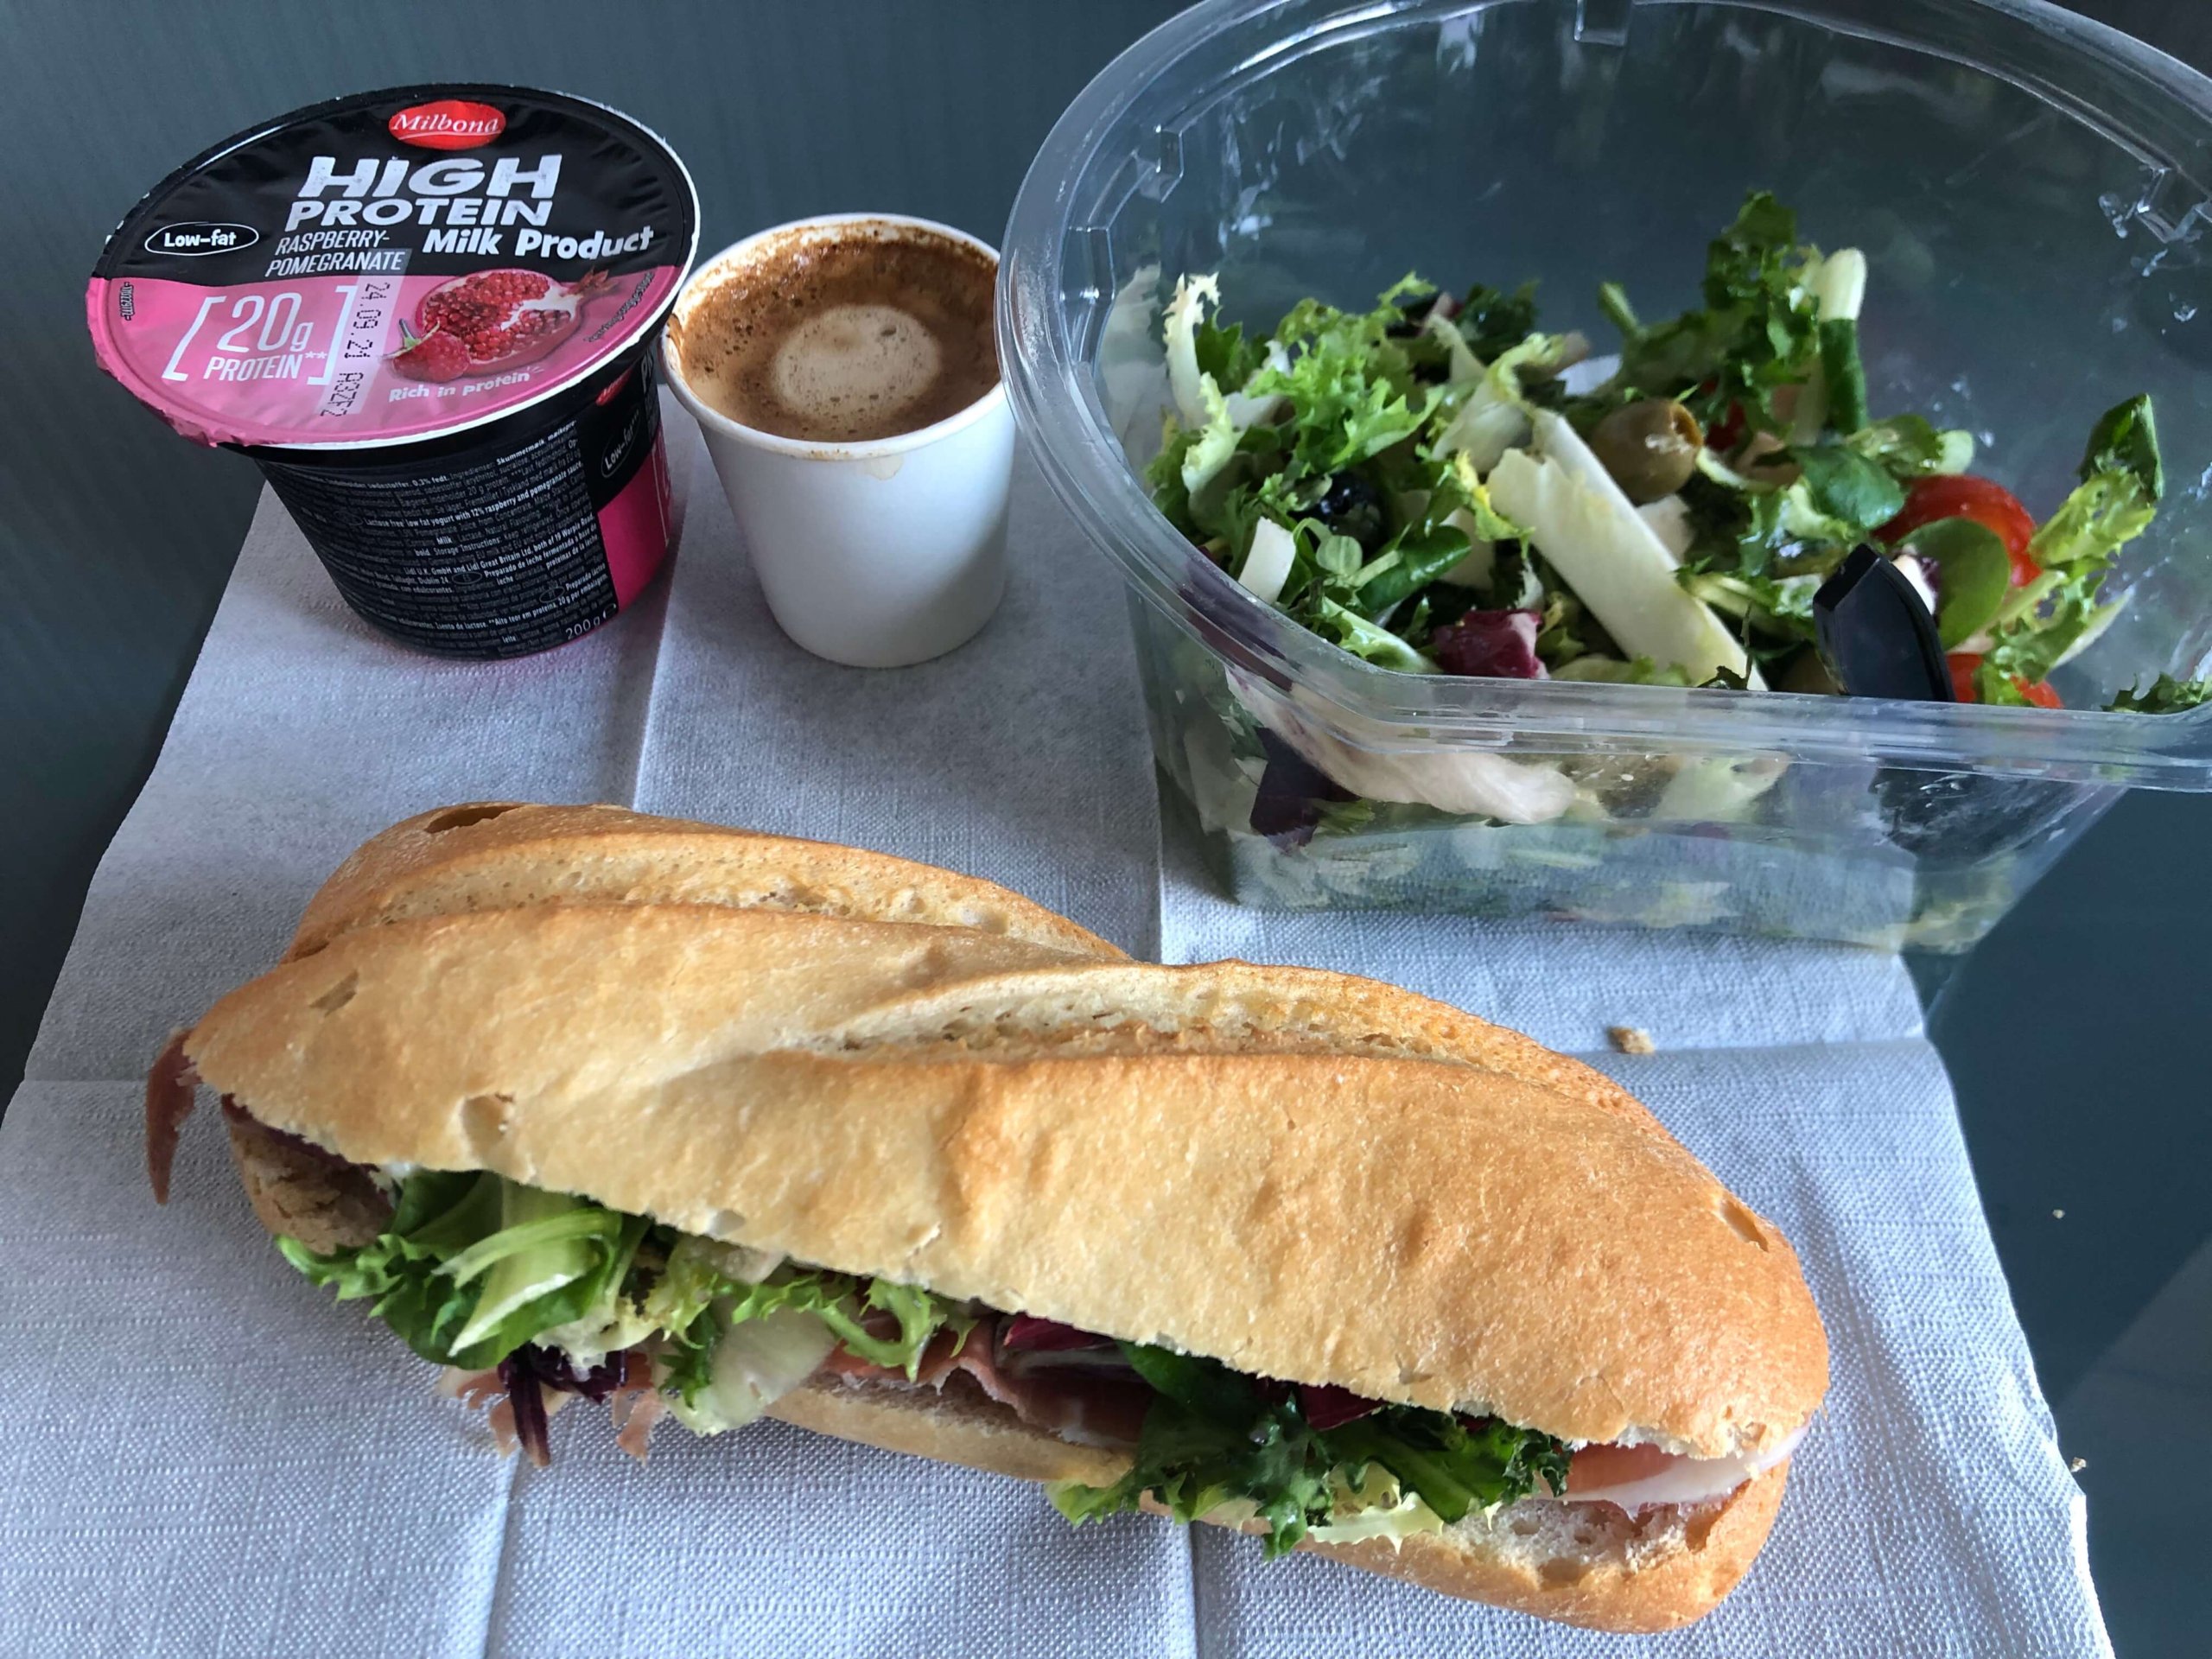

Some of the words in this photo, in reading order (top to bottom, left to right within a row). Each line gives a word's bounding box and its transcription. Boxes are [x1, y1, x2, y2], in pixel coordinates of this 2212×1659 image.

[391, 113, 499, 133] Milbona
[297, 154, 562, 199] HIGH
[284, 198, 553, 232] PROTEIN
[163, 228, 237, 248] Low-fat
[274, 229, 391, 256] RASPBERRY-
[423, 226, 503, 257] Milk
[514, 226, 654, 260] Product
[265, 251, 404, 276] POMEGRANATE
[216, 291, 315, 353] 20g
[389, 384, 430, 403] Rich
[436, 385, 456, 398] in
[461, 372, 531, 397] protein
[405, 518, 420, 527] low
[419, 517, 431, 526] fat
[431, 514, 455, 527] yogurt
[454, 509, 471, 521] with
[471, 505, 485, 518] 12%
[484, 495, 517, 516] raspberry
[517, 488, 530, 503] and
[529, 470, 567, 499] pomegranate
[467, 486, 477, 496] 20
[465, 560, 480, 572] Lidl
[479, 556, 499, 570] Great
[498, 550, 521, 565] Britain
[532, 538, 549, 553] both
[548, 534, 555, 546] of
[483, 563, 518, 579] Preparado
[517, 559, 526, 569] de
[525, 553, 543, 567] leche
[543, 536, 575, 559] fermentada
[496, 574, 514, 587] leche
[571, 546, 579, 556] de
[455, 620, 465, 631] de
[564, 617, 592, 641] 200
